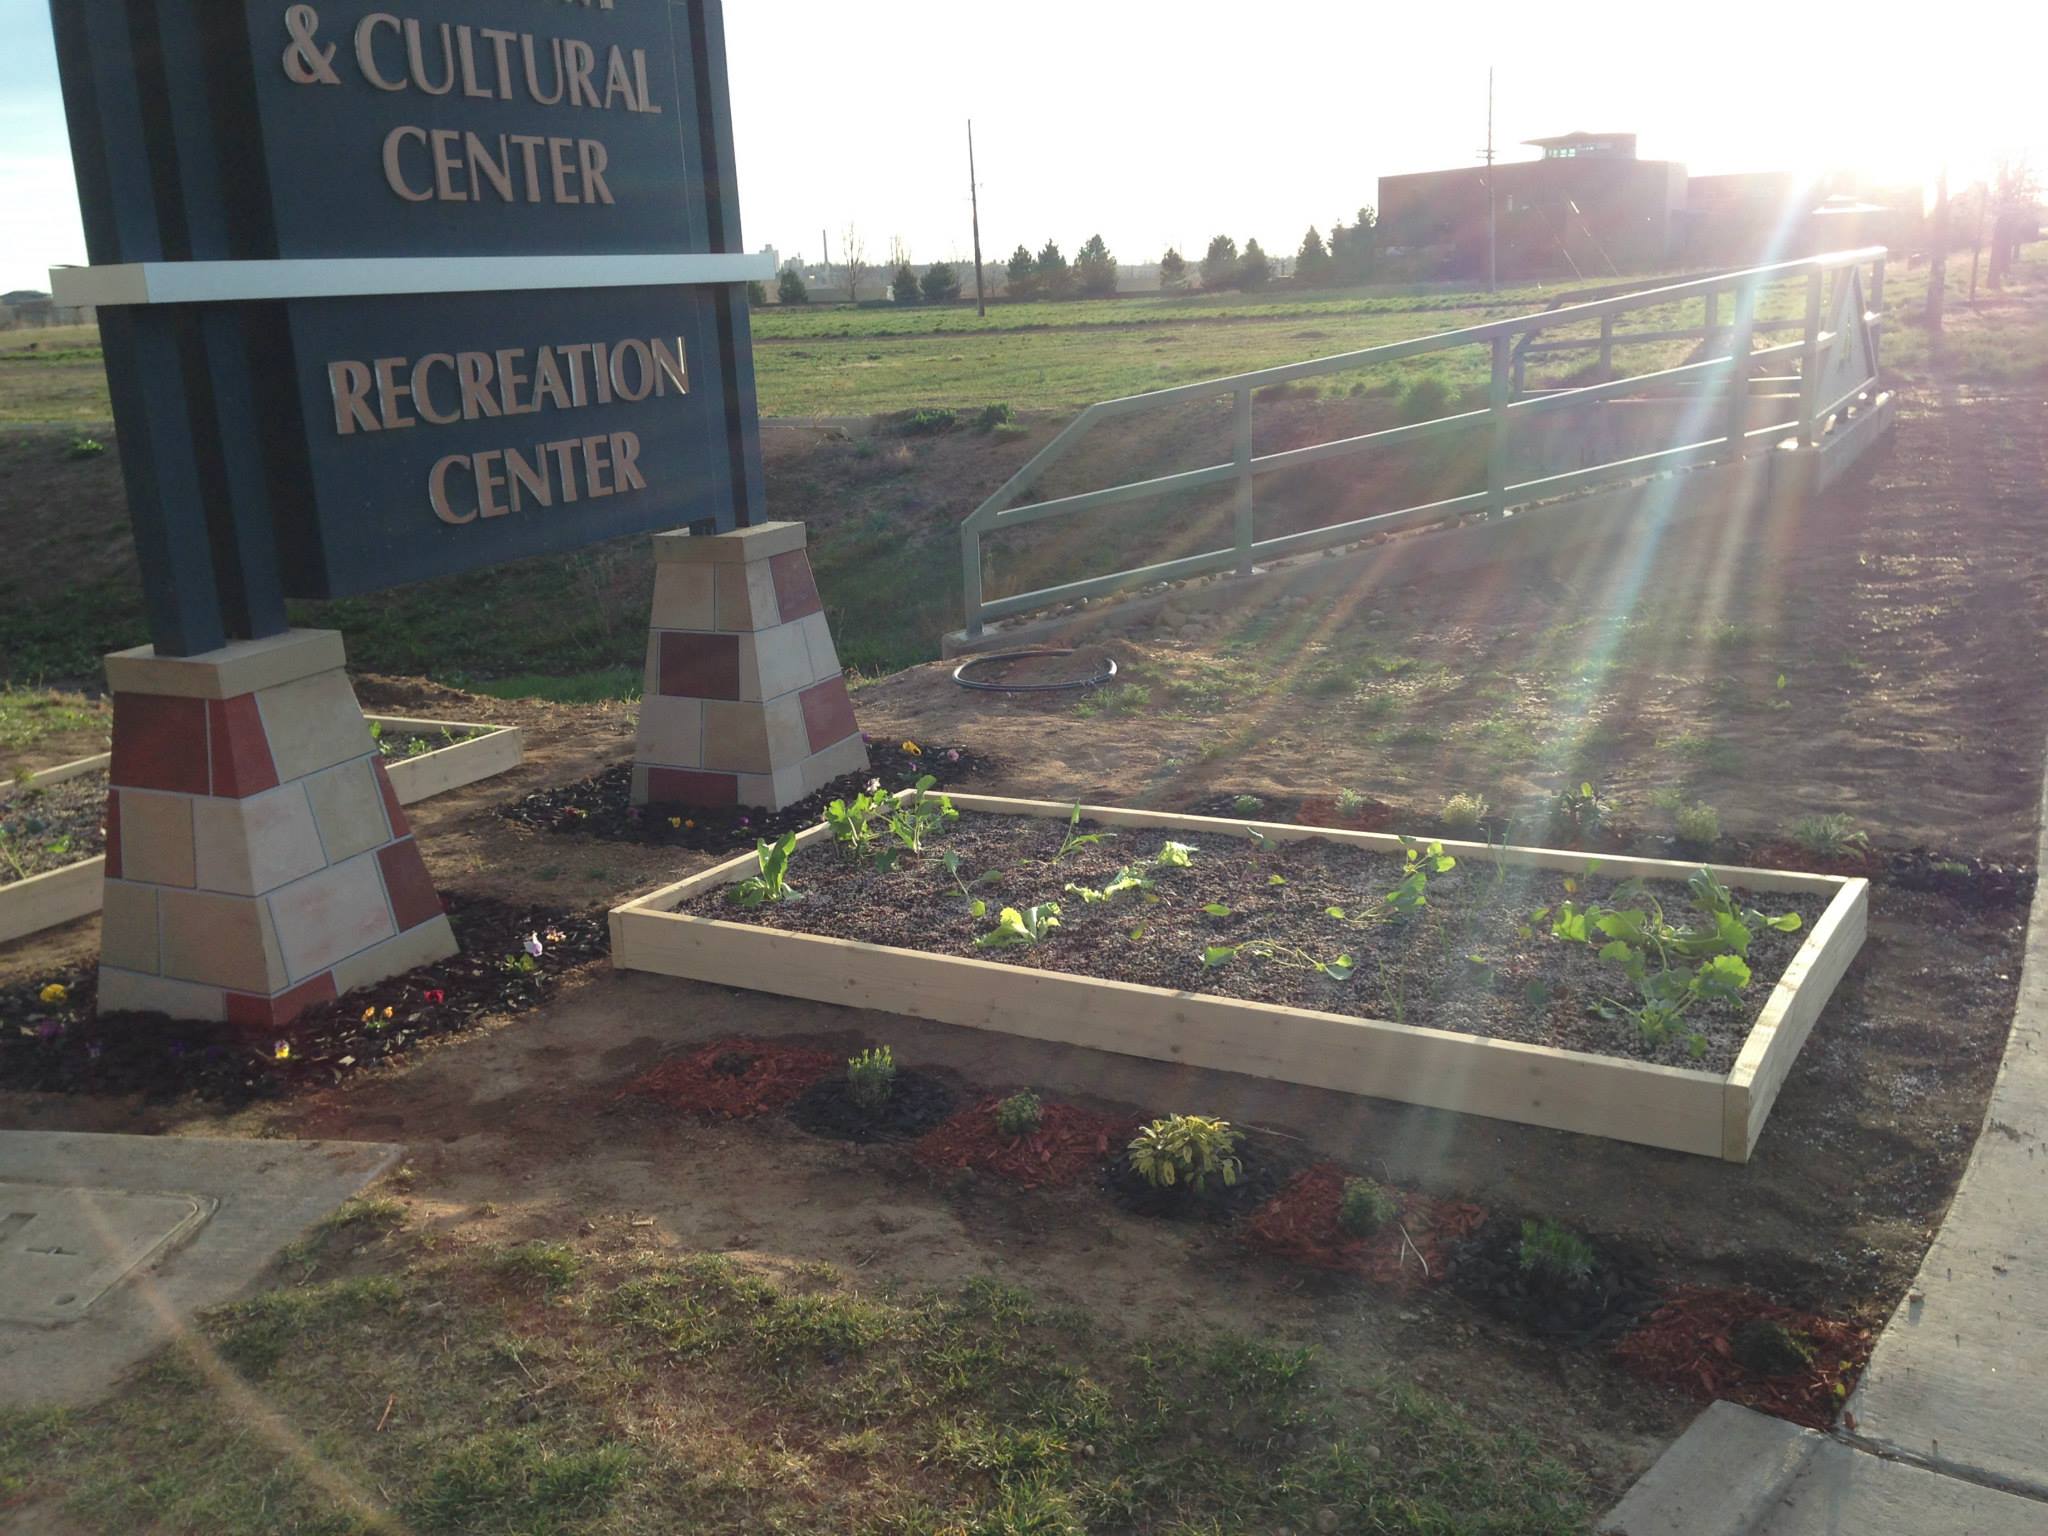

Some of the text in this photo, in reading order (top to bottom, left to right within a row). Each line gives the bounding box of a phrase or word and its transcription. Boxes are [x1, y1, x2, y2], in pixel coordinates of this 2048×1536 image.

[282, 4, 662, 114] & CULTURAL
[382, 126, 615, 204] CENTER
[328, 336, 690, 434] RECREATION
[428, 431, 647, 525] CENTER
